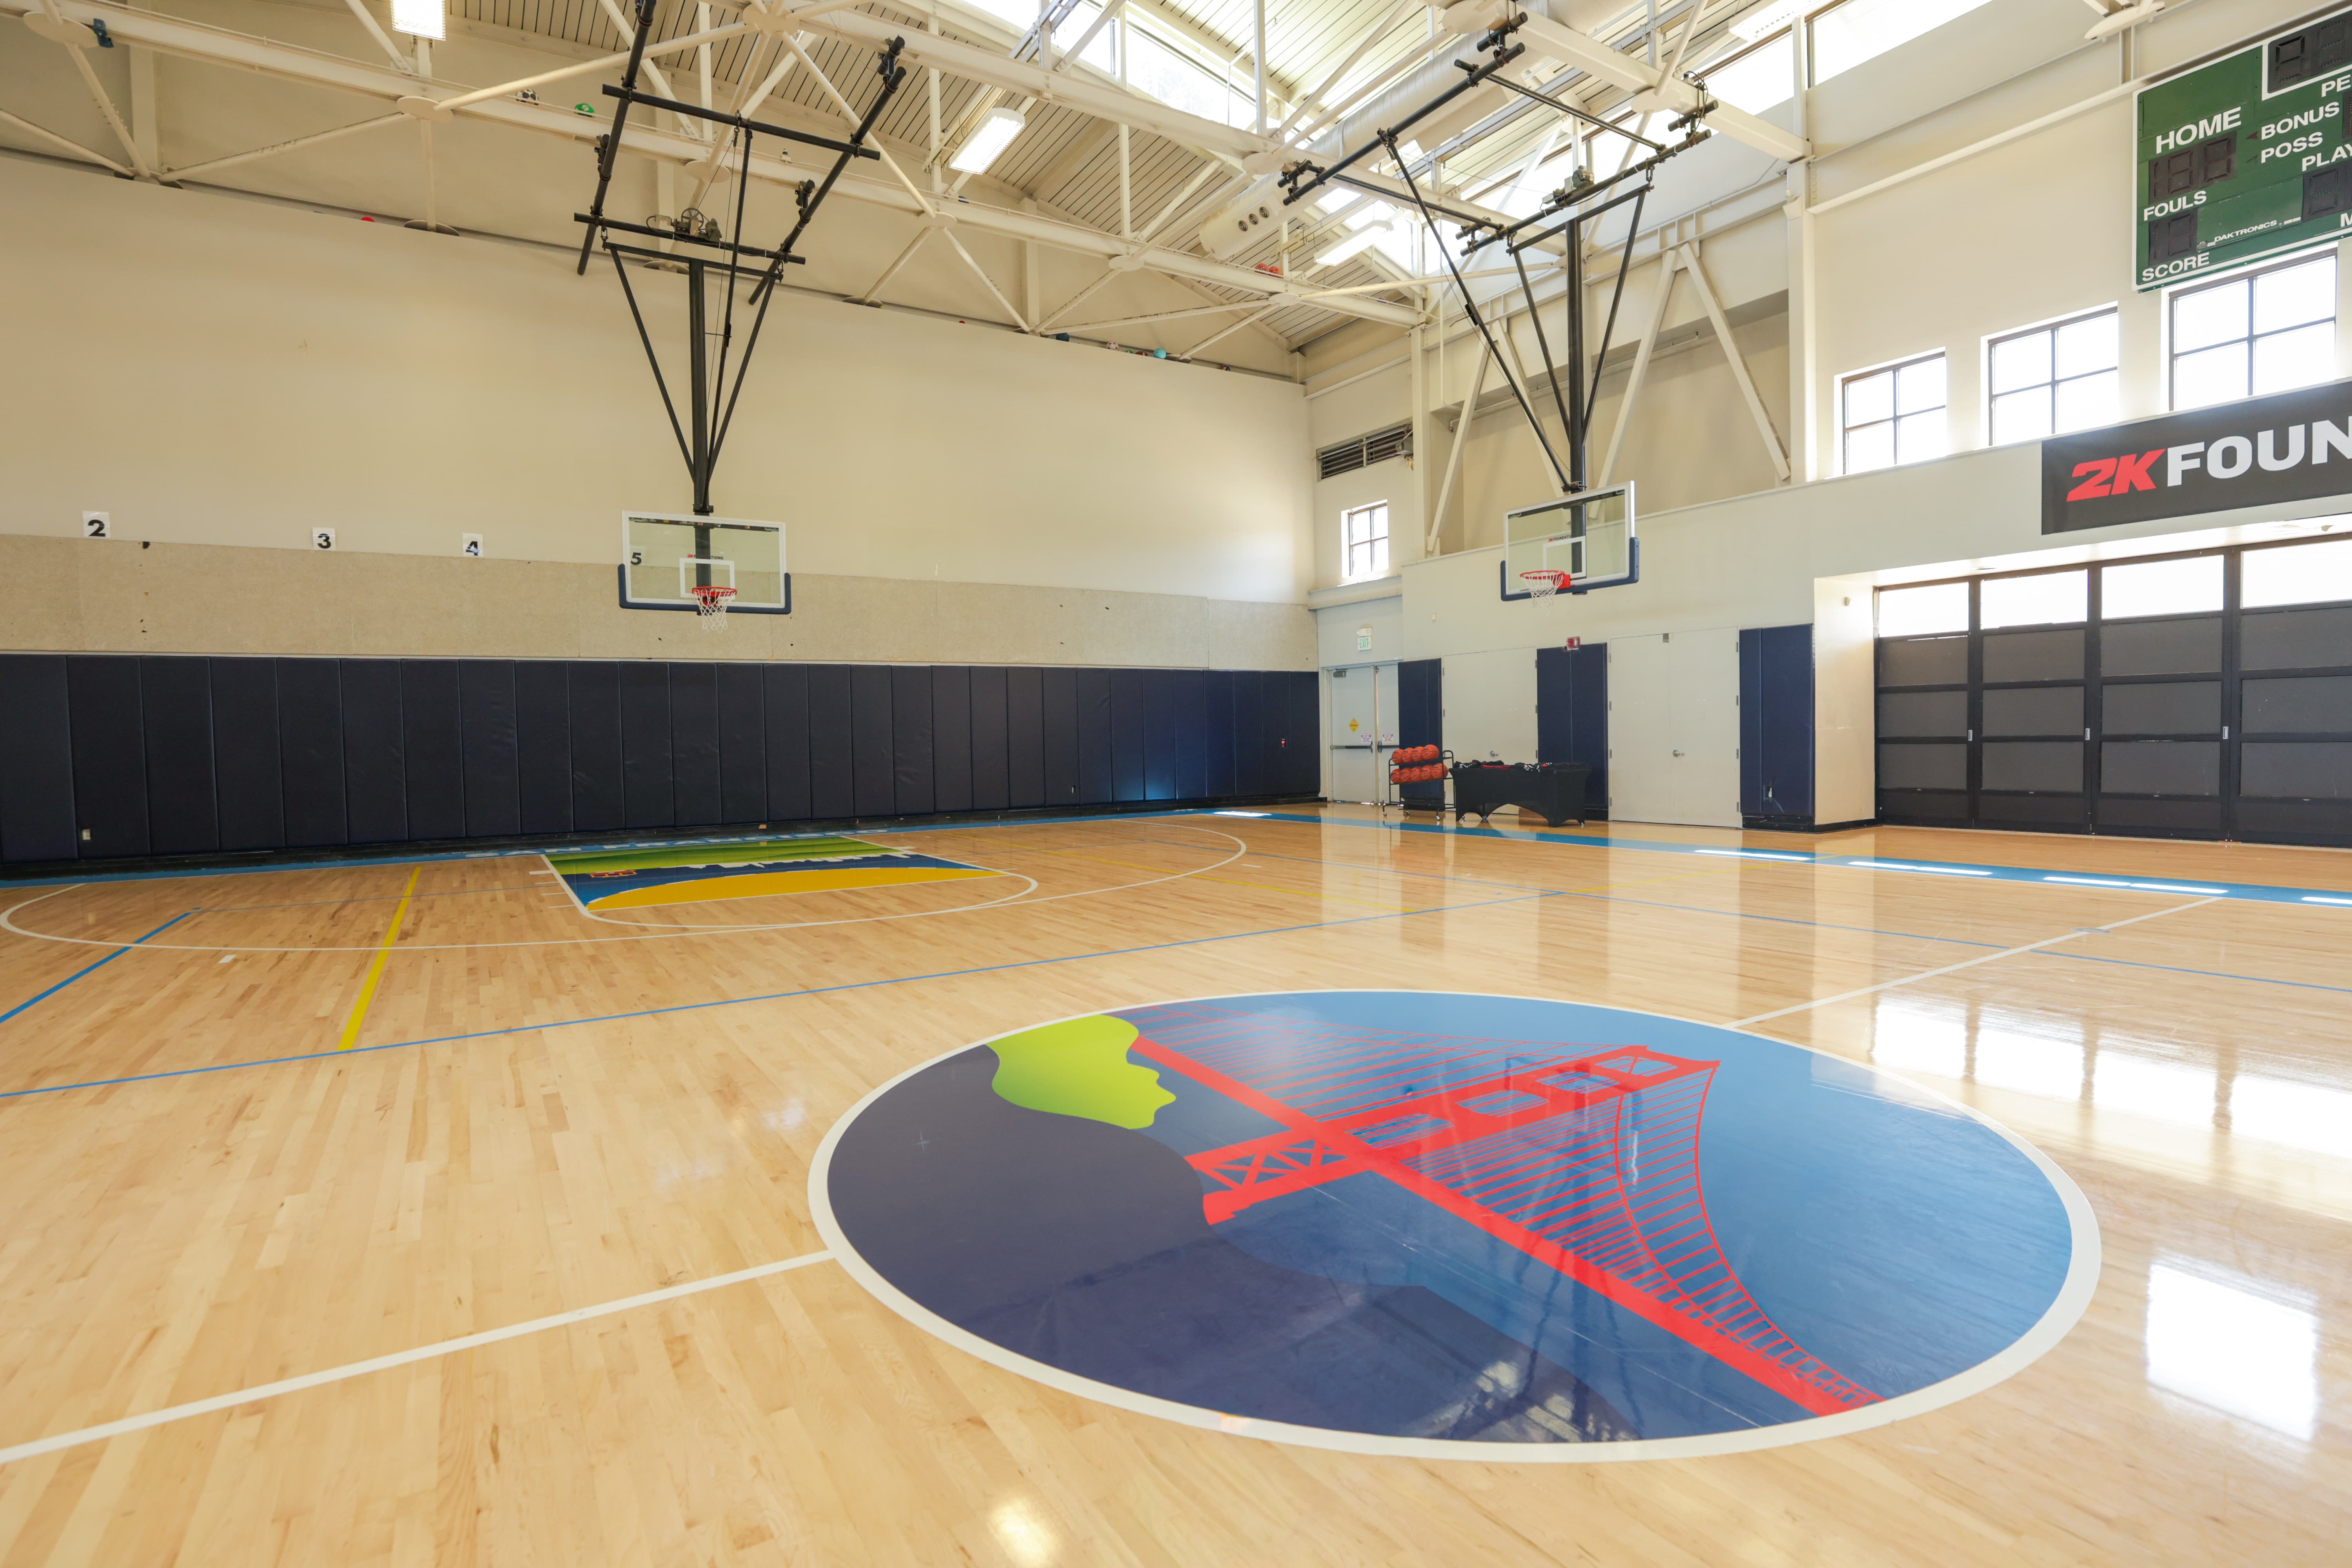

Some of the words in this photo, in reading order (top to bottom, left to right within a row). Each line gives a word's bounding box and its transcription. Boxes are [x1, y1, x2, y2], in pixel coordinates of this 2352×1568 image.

[2156, 106, 2241, 154] HOME
[2261, 102, 2340, 140] BONUS
[2261, 140, 2323, 163] POSS
[2144, 191, 2207, 221] FOULS
[2214, 220, 2277, 242] DAKTRONICS
[2142, 252, 2210, 281] SCORE
[87, 519, 106, 537] 2
[317, 533, 331, 549] 3
[465, 541, 480, 556] 4
[630, 552, 642, 565] 5
[1360, 639, 1368, 648] EXIT
[465, 847, 582, 857] SAN
[602, 829, 888, 849] FRANCISCO
